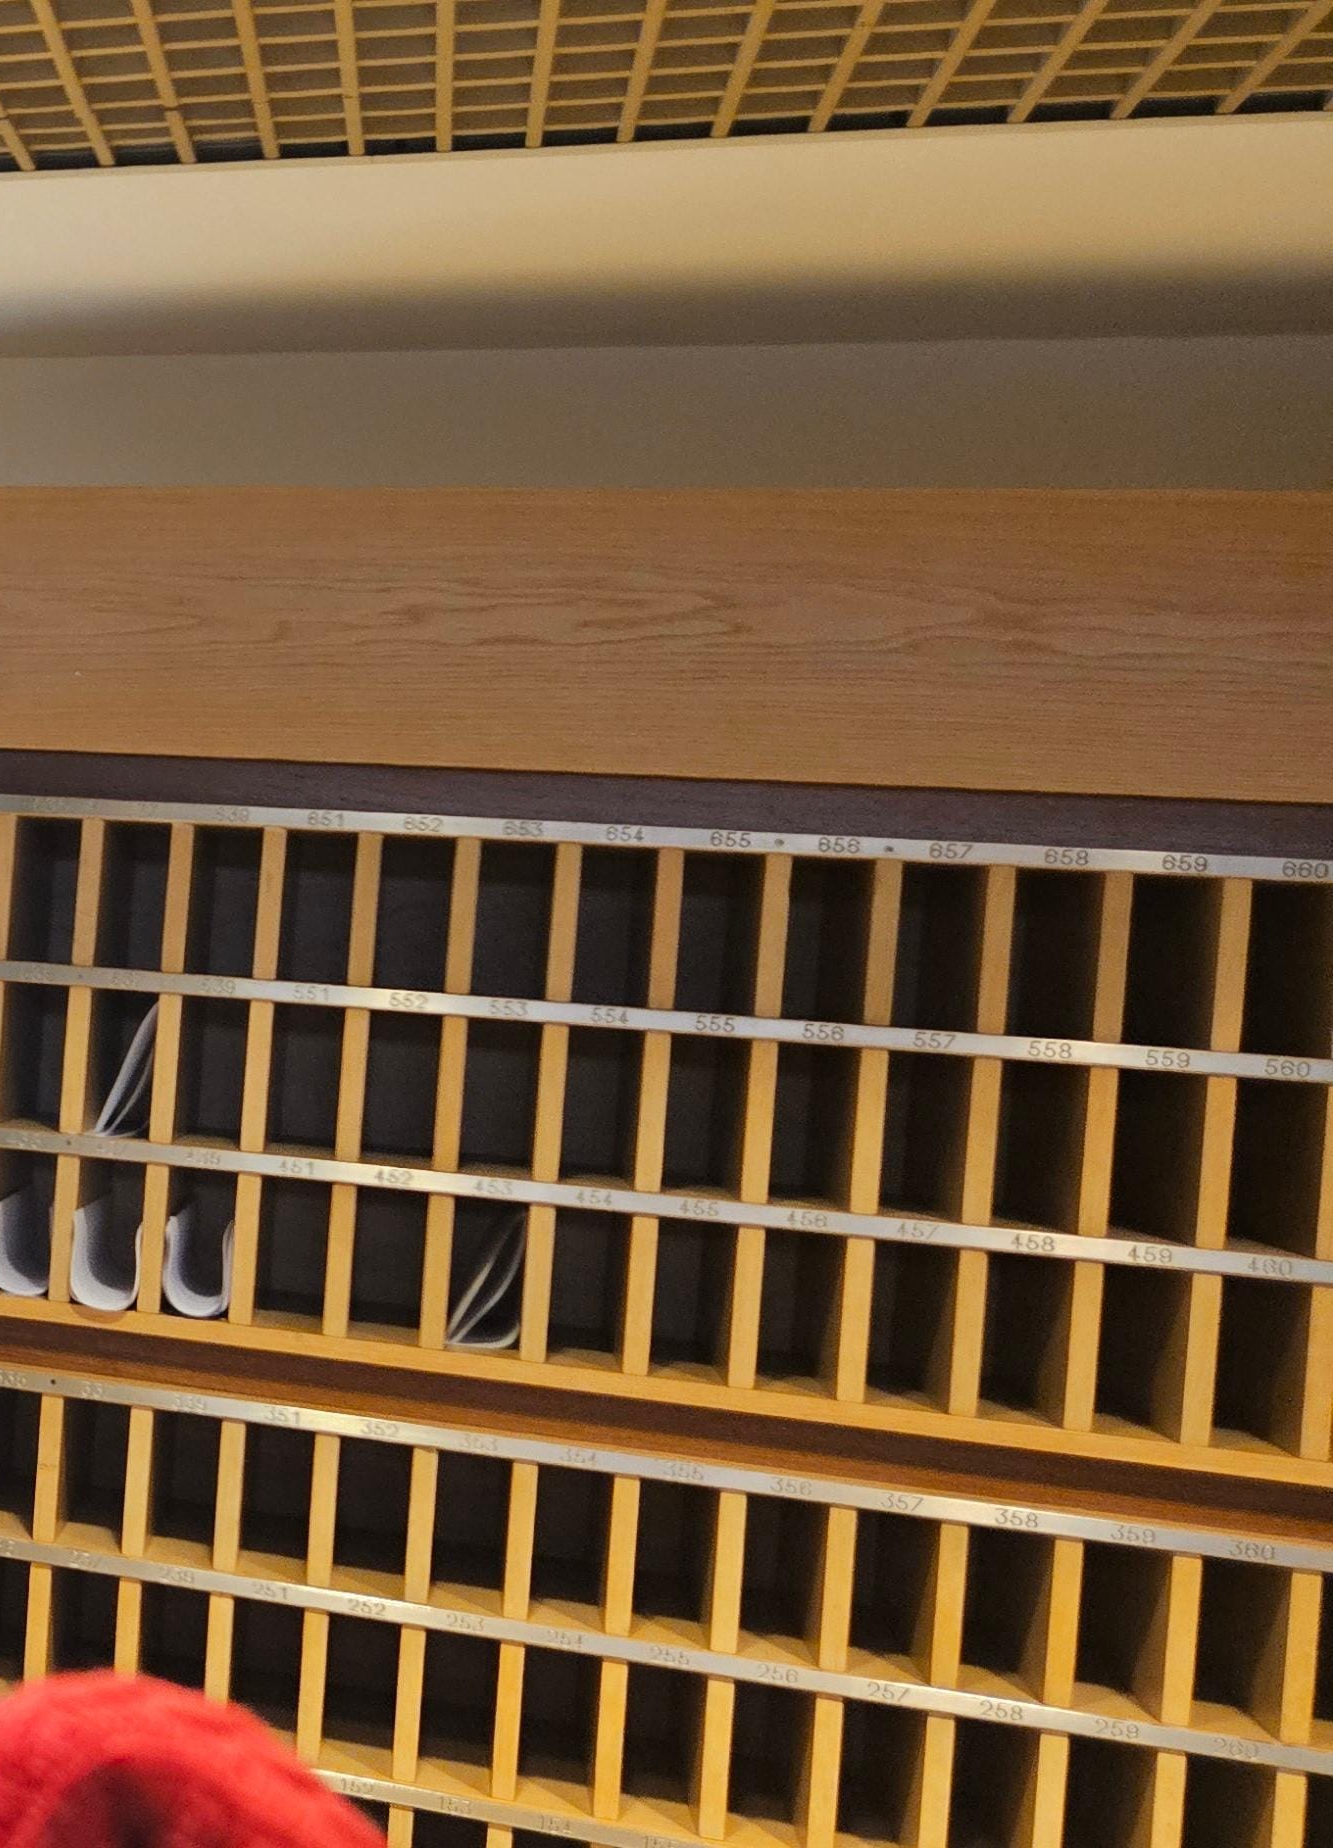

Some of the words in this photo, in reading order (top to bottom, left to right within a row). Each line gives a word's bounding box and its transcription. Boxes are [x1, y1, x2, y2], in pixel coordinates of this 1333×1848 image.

[307, 810, 345, 827] 651
[403, 816, 443, 833] 652
[502, 820, 544, 837] 653
[605, 826, 644, 843] 654
[710, 830, 751, 848] 655
[818, 837, 861, 854] 656
[929, 843, 972, 860] 657
[1045, 848, 1089, 866] 658
[1162, 855, 1208, 873] 659
[1282, 861, 1330, 879] 660
[293, 985, 330, 1001] 551
[389, 992, 430, 1010] 552
[489, 1000, 528, 1017] 553
[590, 1007, 629, 1025] 554
[695, 1015, 735, 1033] 555
[802, 1023, 845, 1041] 556
[913, 1031, 956, 1049] 557
[1028, 1040, 1072, 1059] 558
[1145, 1049, 1190, 1068] 559
[1264, 1058, 1310, 1078] 560
[375, 1170, 411, 1187] 452
[473, 1180, 513, 1197] 453
[575, 1190, 613, 1208] 454
[679, 1200, 719, 1218] 455
[786, 1211, 827, 1229] 456
[897, 1222, 939, 1240] 457
[1011, 1233, 1055, 1252] 458
[1128, 1245, 1173, 1264] 459
[264, 1406, 299, 1424] 351
[360, 1420, 399, 1438] 352
[663, 1461, 704, 1481] 355
[770, 1477, 812, 1497] 356
[881, 1493, 924, 1512] 357
[995, 1509, 1039, 1529] 358
[1110, 1525, 1156, 1546] 359
[1230, 1541, 1276, 1562] 360
[253, 1582, 289, 1600] 251
[348, 1598, 386, 1617] 252
[447, 1614, 484, 1632] 253
[650, 1646, 690, 1666] 255
[757, 1664, 799, 1685] 256
[867, 1681, 911, 1701] 257
[980, 1700, 1024, 1721] 258
[1095, 1719, 1140, 1740] 259
